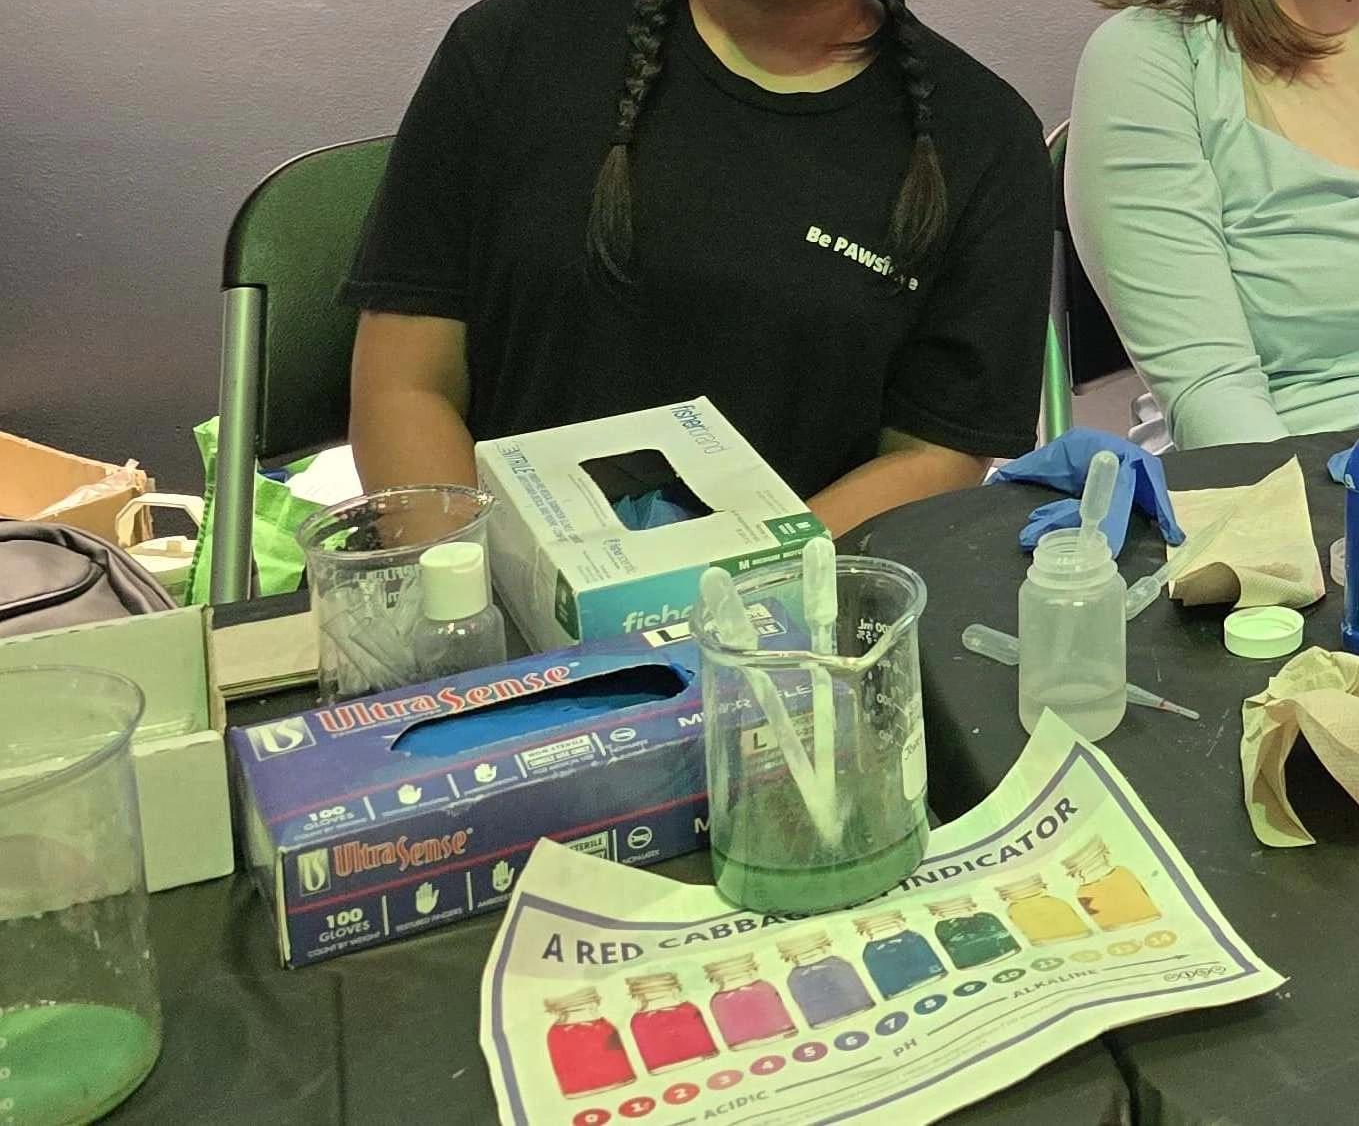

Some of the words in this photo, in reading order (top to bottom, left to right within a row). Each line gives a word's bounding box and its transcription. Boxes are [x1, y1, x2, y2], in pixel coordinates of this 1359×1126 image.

[805, 225, 832, 248] Be
[308, 805, 346, 822] 100
[332, 829, 468, 877] UltraSense
[541, 932, 564, 964] A
[575, 941, 645, 965] RED
[658, 912, 811, 950] CABBA
[899, 796, 1079, 893] INDICATOR
[325, 907, 364, 929] 100
[319, 919, 370, 943] GLOVES
[703, 1090, 769, 1120] ACIDIC
